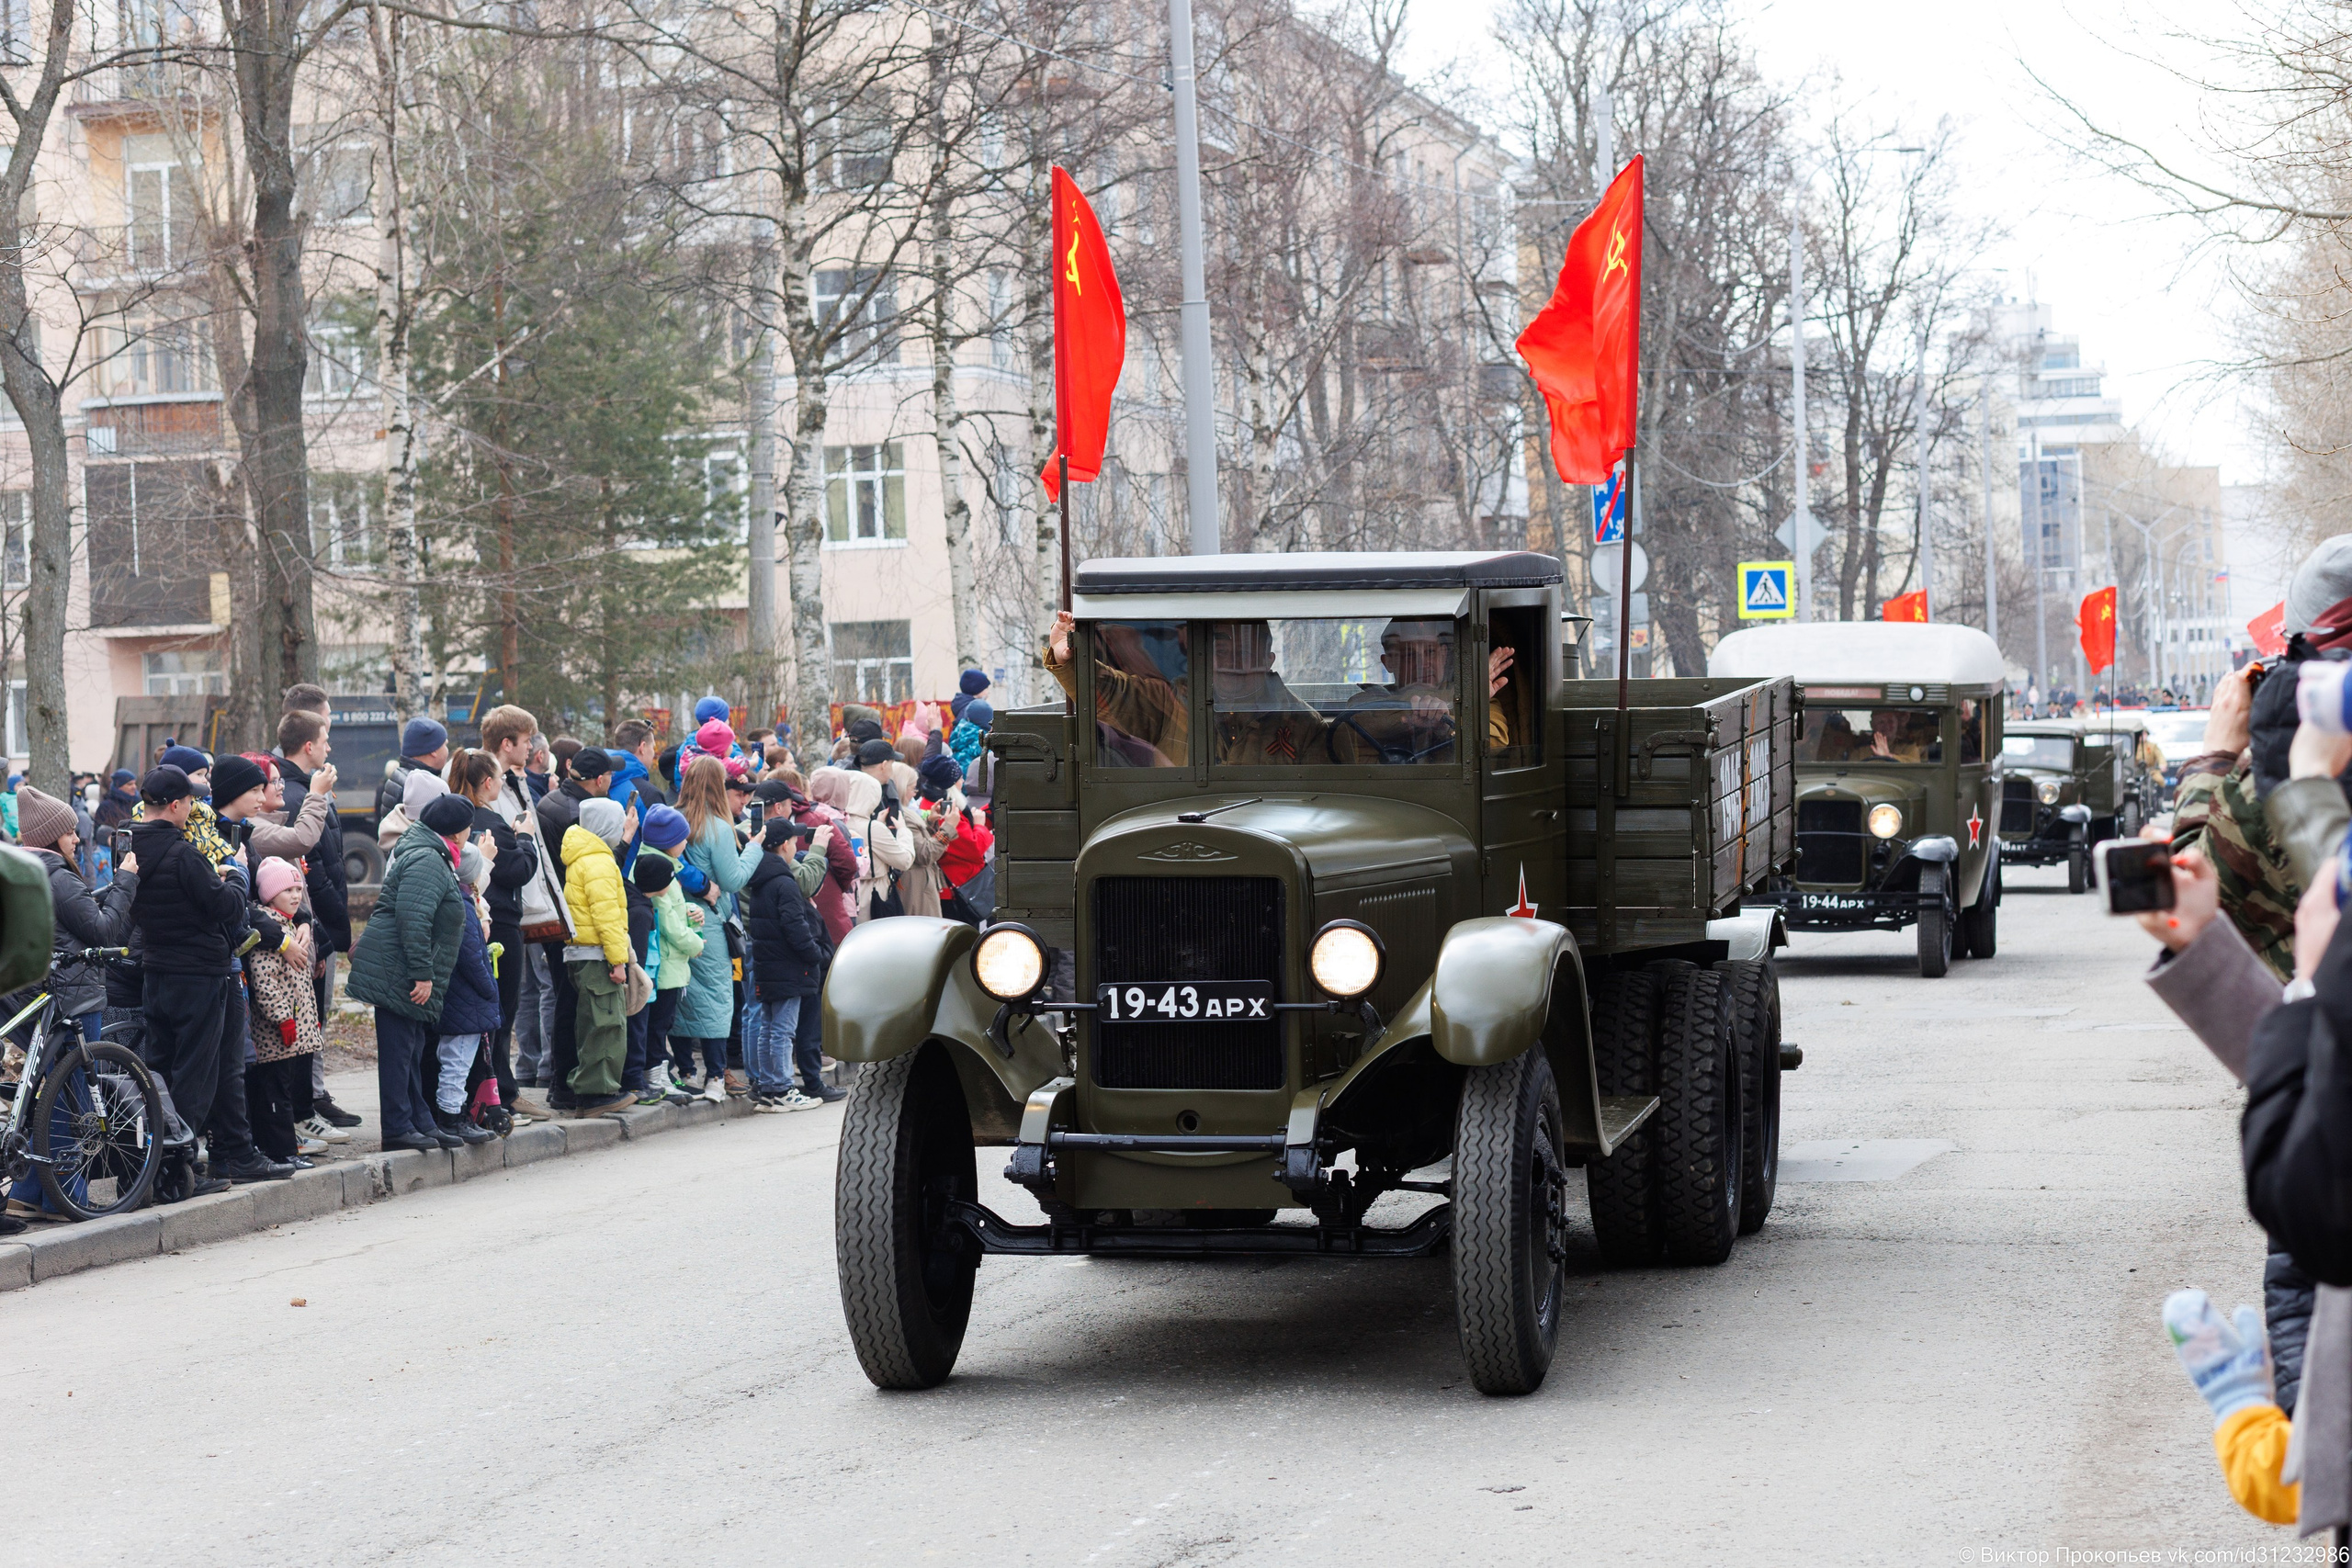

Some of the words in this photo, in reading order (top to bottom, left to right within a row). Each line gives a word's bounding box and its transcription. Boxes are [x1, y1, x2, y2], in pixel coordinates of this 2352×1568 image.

[1802, 895, 1838, 908] 19-44
[1839, 899, 1865, 908] АРХ
[1107, 986, 1199, 1019] 19-43
[1205, 998, 1266, 1017] АРХ
